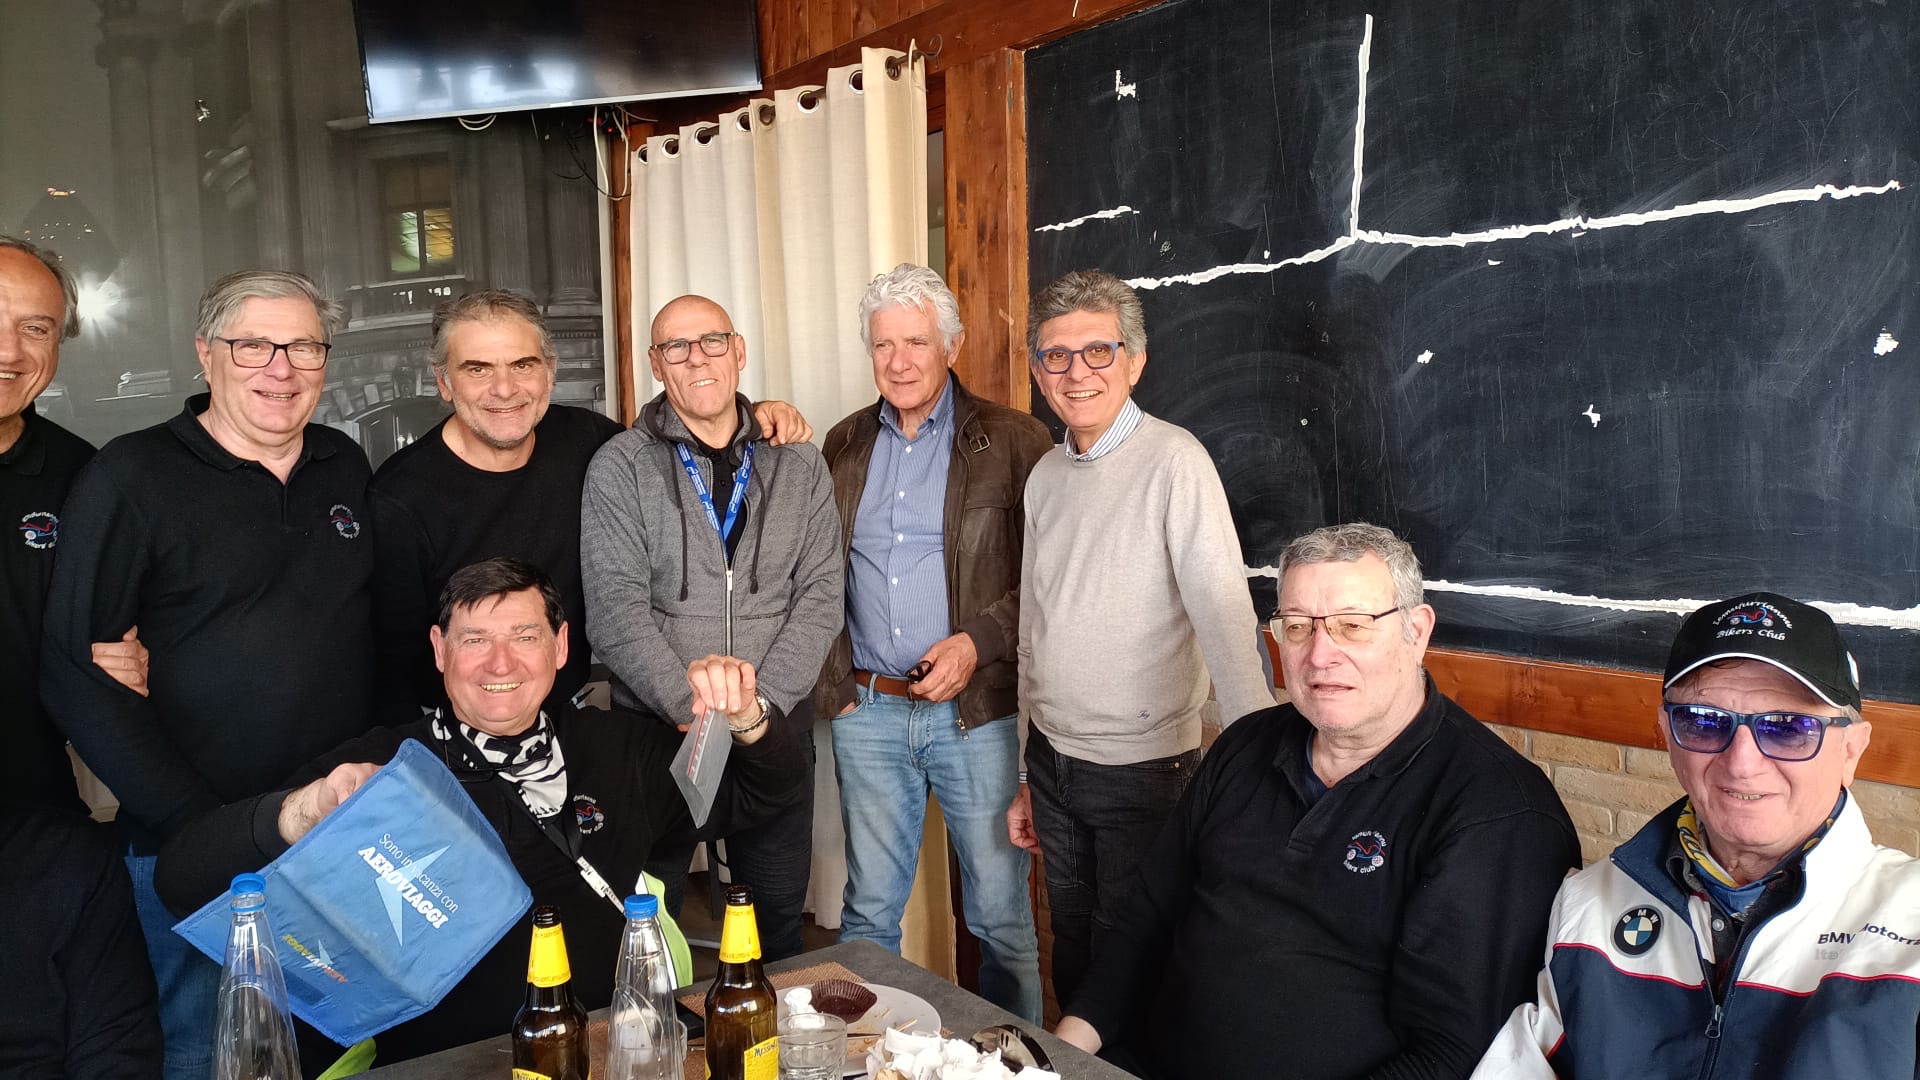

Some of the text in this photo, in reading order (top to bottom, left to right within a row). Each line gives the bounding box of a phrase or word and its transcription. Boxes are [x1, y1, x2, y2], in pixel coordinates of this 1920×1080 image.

[1757, 629, 1786, 641] Club
[358, 846, 449, 929] AEROVIAGGI
[378, 833, 404, 860] Sono
[400, 853, 414, 868] in
[440, 895, 459, 913] con
[1622, 909, 1660, 924] BMW
